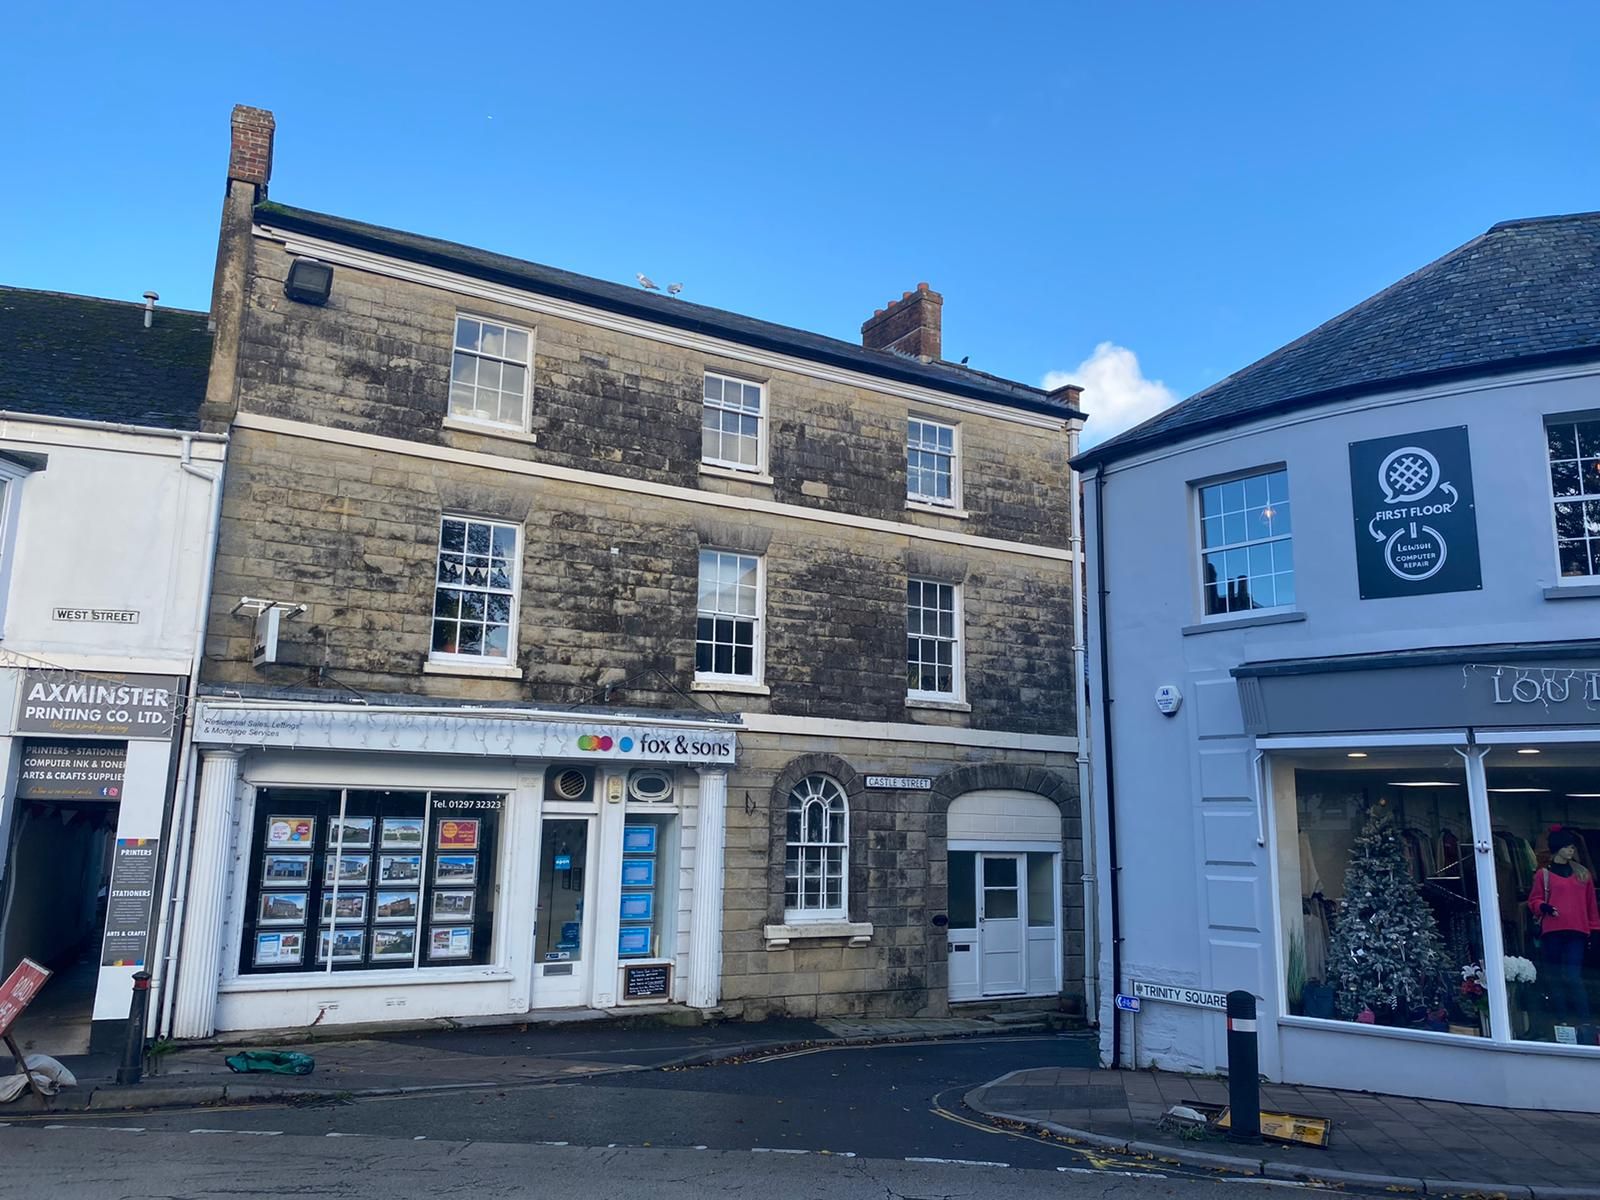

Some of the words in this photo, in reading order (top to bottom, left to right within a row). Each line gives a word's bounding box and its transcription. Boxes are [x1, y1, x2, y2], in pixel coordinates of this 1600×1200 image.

[1376, 508, 1407, 521] FIRST
[1410, 503, 1451, 517] FLOOR
[1395, 553, 1436, 562] COMPUTER
[1403, 561, 1429, 569] REPAIR
[57, 610, 88, 620] WEST
[93, 611, 135, 622] STREET
[1491, 675, 1570, 703] LOU
[27, 683, 169, 707] AXMINSTER
[25, 706, 102, 722] PRINTING
[106, 709, 133, 723] CO.
[137, 711, 167, 724] LTD.
[204, 718, 246, 727] Residential
[211, 727, 247, 736] Mortgage
[248, 728, 280, 737] Services
[640, 733, 670, 754] fox
[674, 735, 689, 754] &
[691, 741, 730, 757] sons
[25, 746, 69, 755] PRINTERS
[24, 758, 71, 768] COMPUTER
[73, 759, 89, 768] INK
[91, 760, 98, 768] &
[22, 771, 45, 780] ARTS
[46, 771, 53, 780] &
[54, 772, 86, 781] CRAFTS
[868, 777, 897, 786] CASTLE
[902, 778, 928, 788] STREET
[433, 800, 447, 808] Tel.
[448, 800, 474, 809] 01297
[475, 800, 501, 809] 32323
[1144, 985, 1181, 1000] TRINITY
[1184, 991, 1227, 1008] SQUARE
